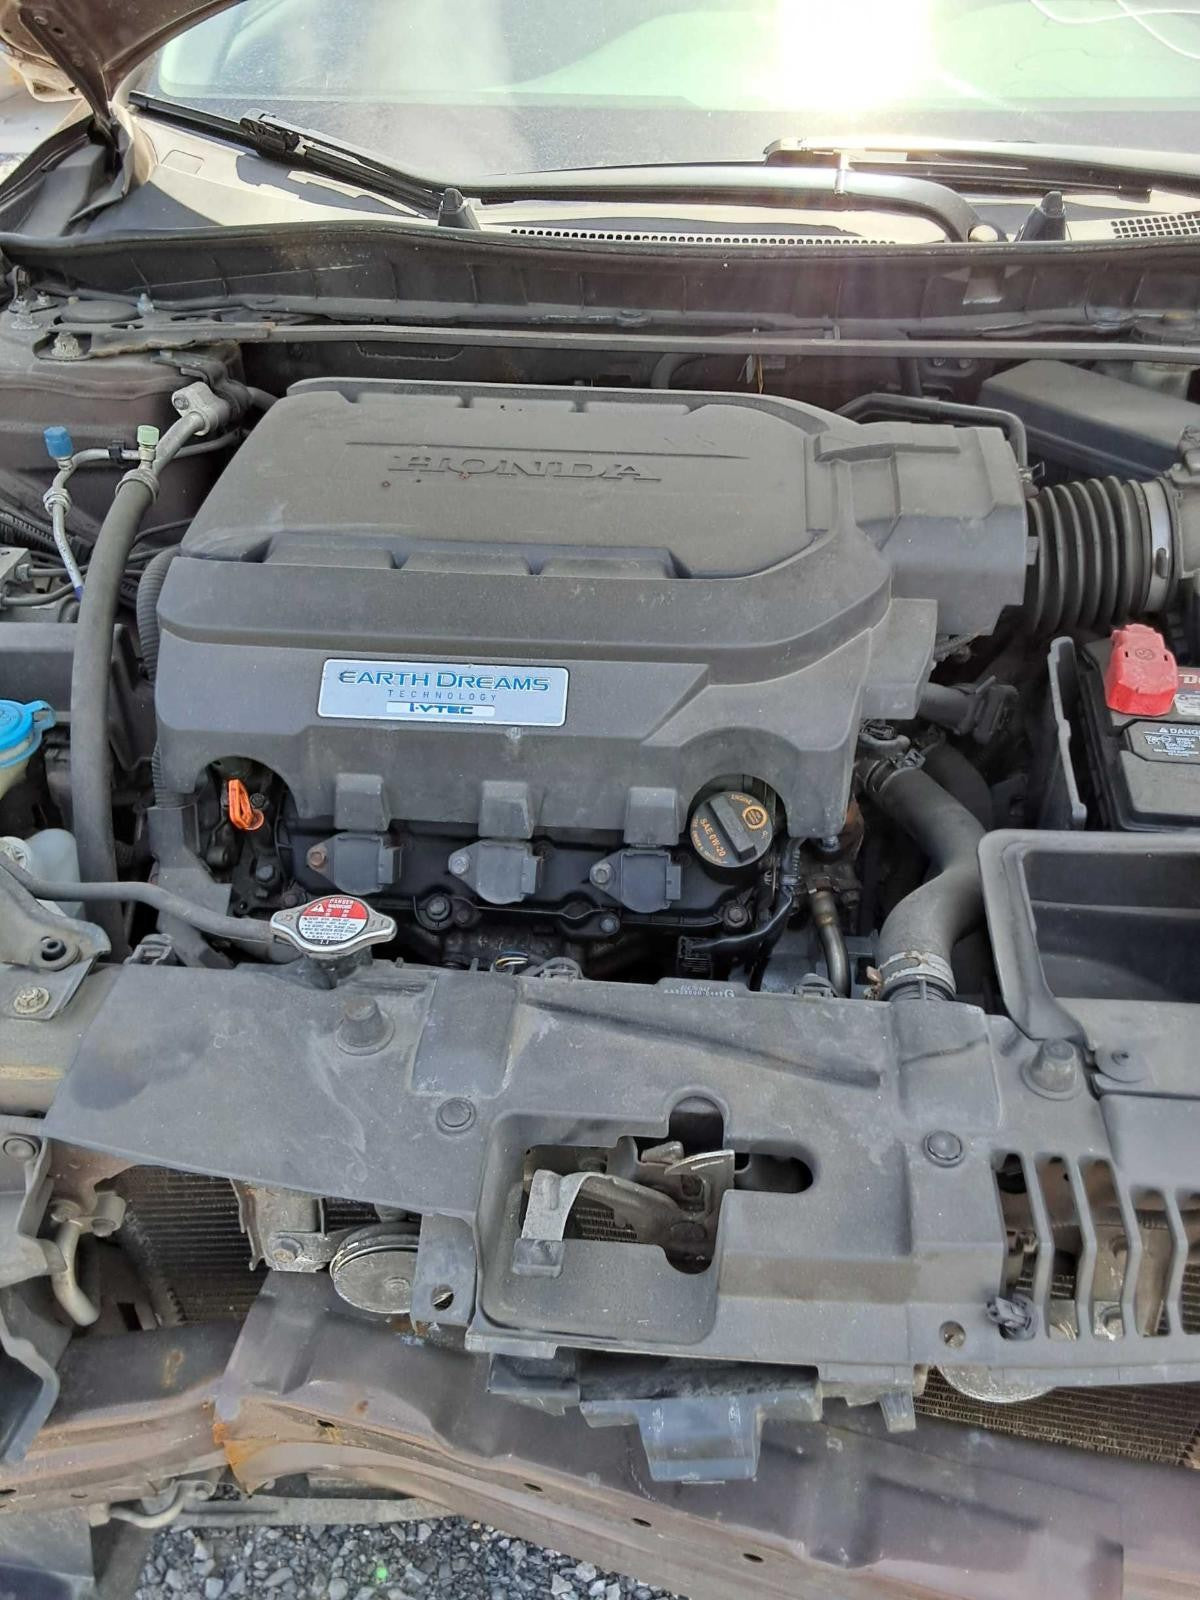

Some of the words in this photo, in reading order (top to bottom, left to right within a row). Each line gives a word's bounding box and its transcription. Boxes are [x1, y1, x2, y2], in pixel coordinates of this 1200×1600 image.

[387, 456, 662, 482] HONDA
[338, 670, 429, 686] EARTH
[436, 672, 550, 691] DREAMS
[388, 689, 498, 701] TECHNOLOGY
[700, 818, 714, 835] SAE
